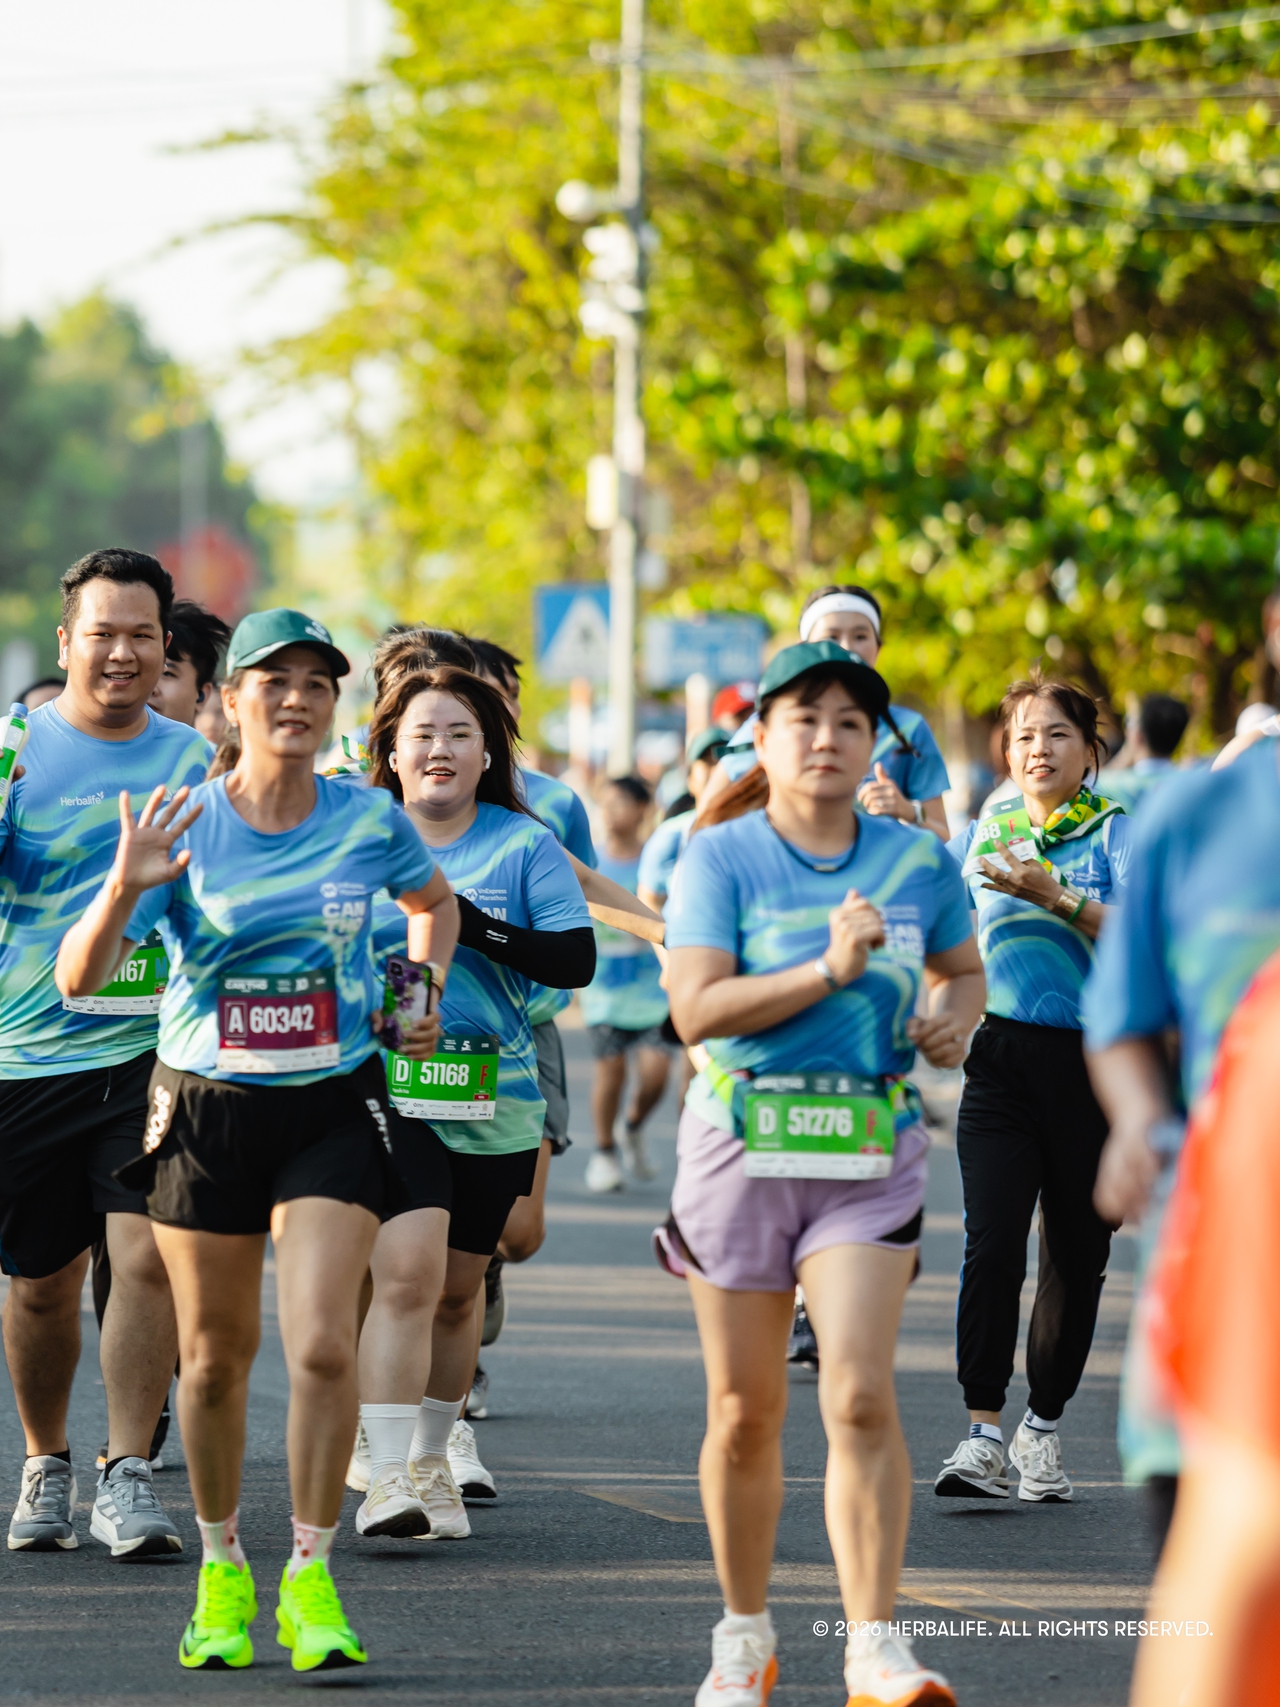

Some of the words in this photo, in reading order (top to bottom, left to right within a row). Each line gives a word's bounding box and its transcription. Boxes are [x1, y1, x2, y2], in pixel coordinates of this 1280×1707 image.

[60, 795, 102, 807] Herbalife
[974, 822, 1001, 845] 88
[1007, 818, 1017, 834] F
[322, 901, 366, 919] CAN
[228, 1006, 244, 1034] A
[249, 1003, 316, 1034] 60342
[395, 1059, 410, 1083] D
[419, 1061, 471, 1087] 51168
[479, 1064, 490, 1087] F
[146, 1084, 172, 1154] SPOR
[757, 1106, 778, 1136] D
[786, 1106, 854, 1138] 51276
[865, 1109, 878, 1138] F
